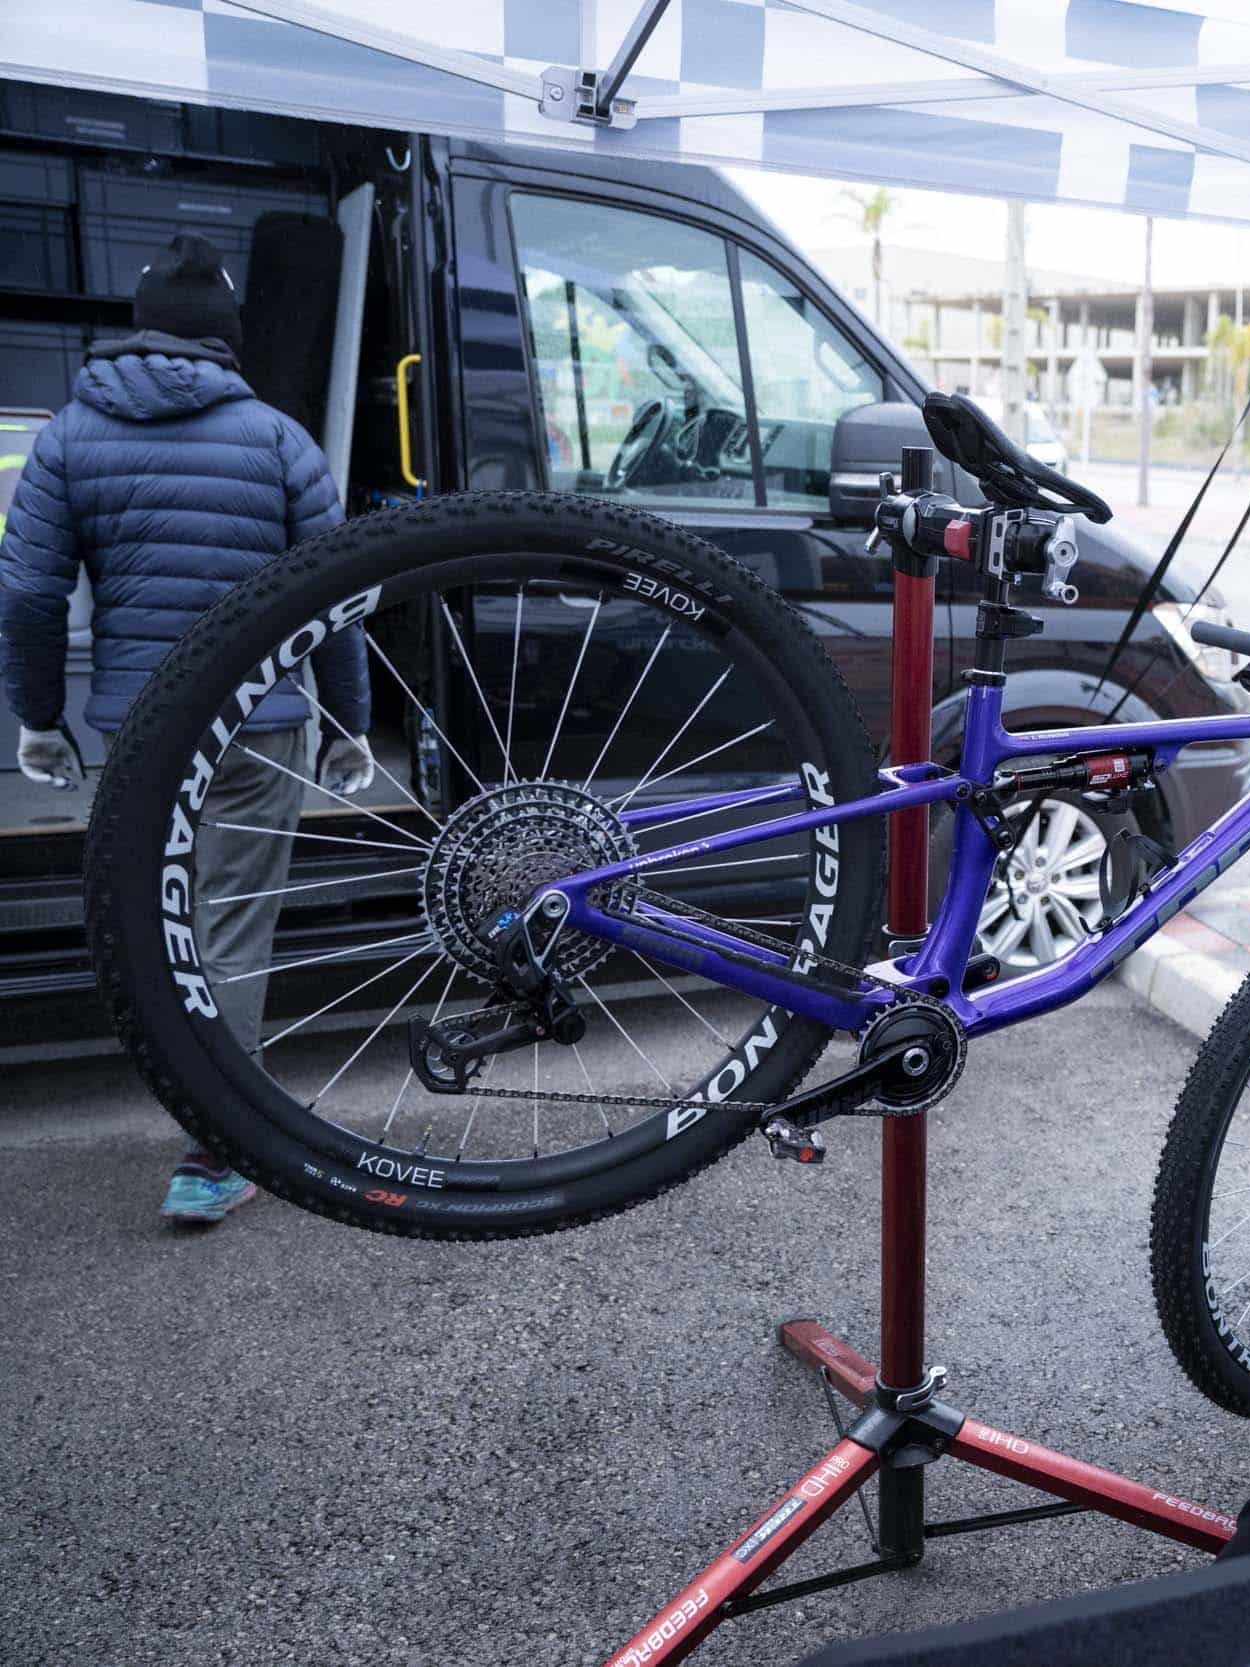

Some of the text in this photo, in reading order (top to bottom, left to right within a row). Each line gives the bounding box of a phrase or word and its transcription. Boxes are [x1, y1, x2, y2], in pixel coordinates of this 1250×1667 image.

[585, 537, 734, 603] PIRELLI
[623, 572, 706, 621] KOVEE
[161, 584, 383, 1019] BONTRAGER
[666, 762, 841, 1141] BONRAGER
[357, 1151, 446, 1189] KOVEE
[364, 1188, 408, 1208] RC
[1152, 1492, 1238, 1530] FEEDBAC
[620, 1587, 710, 1667] FEEDBAC
